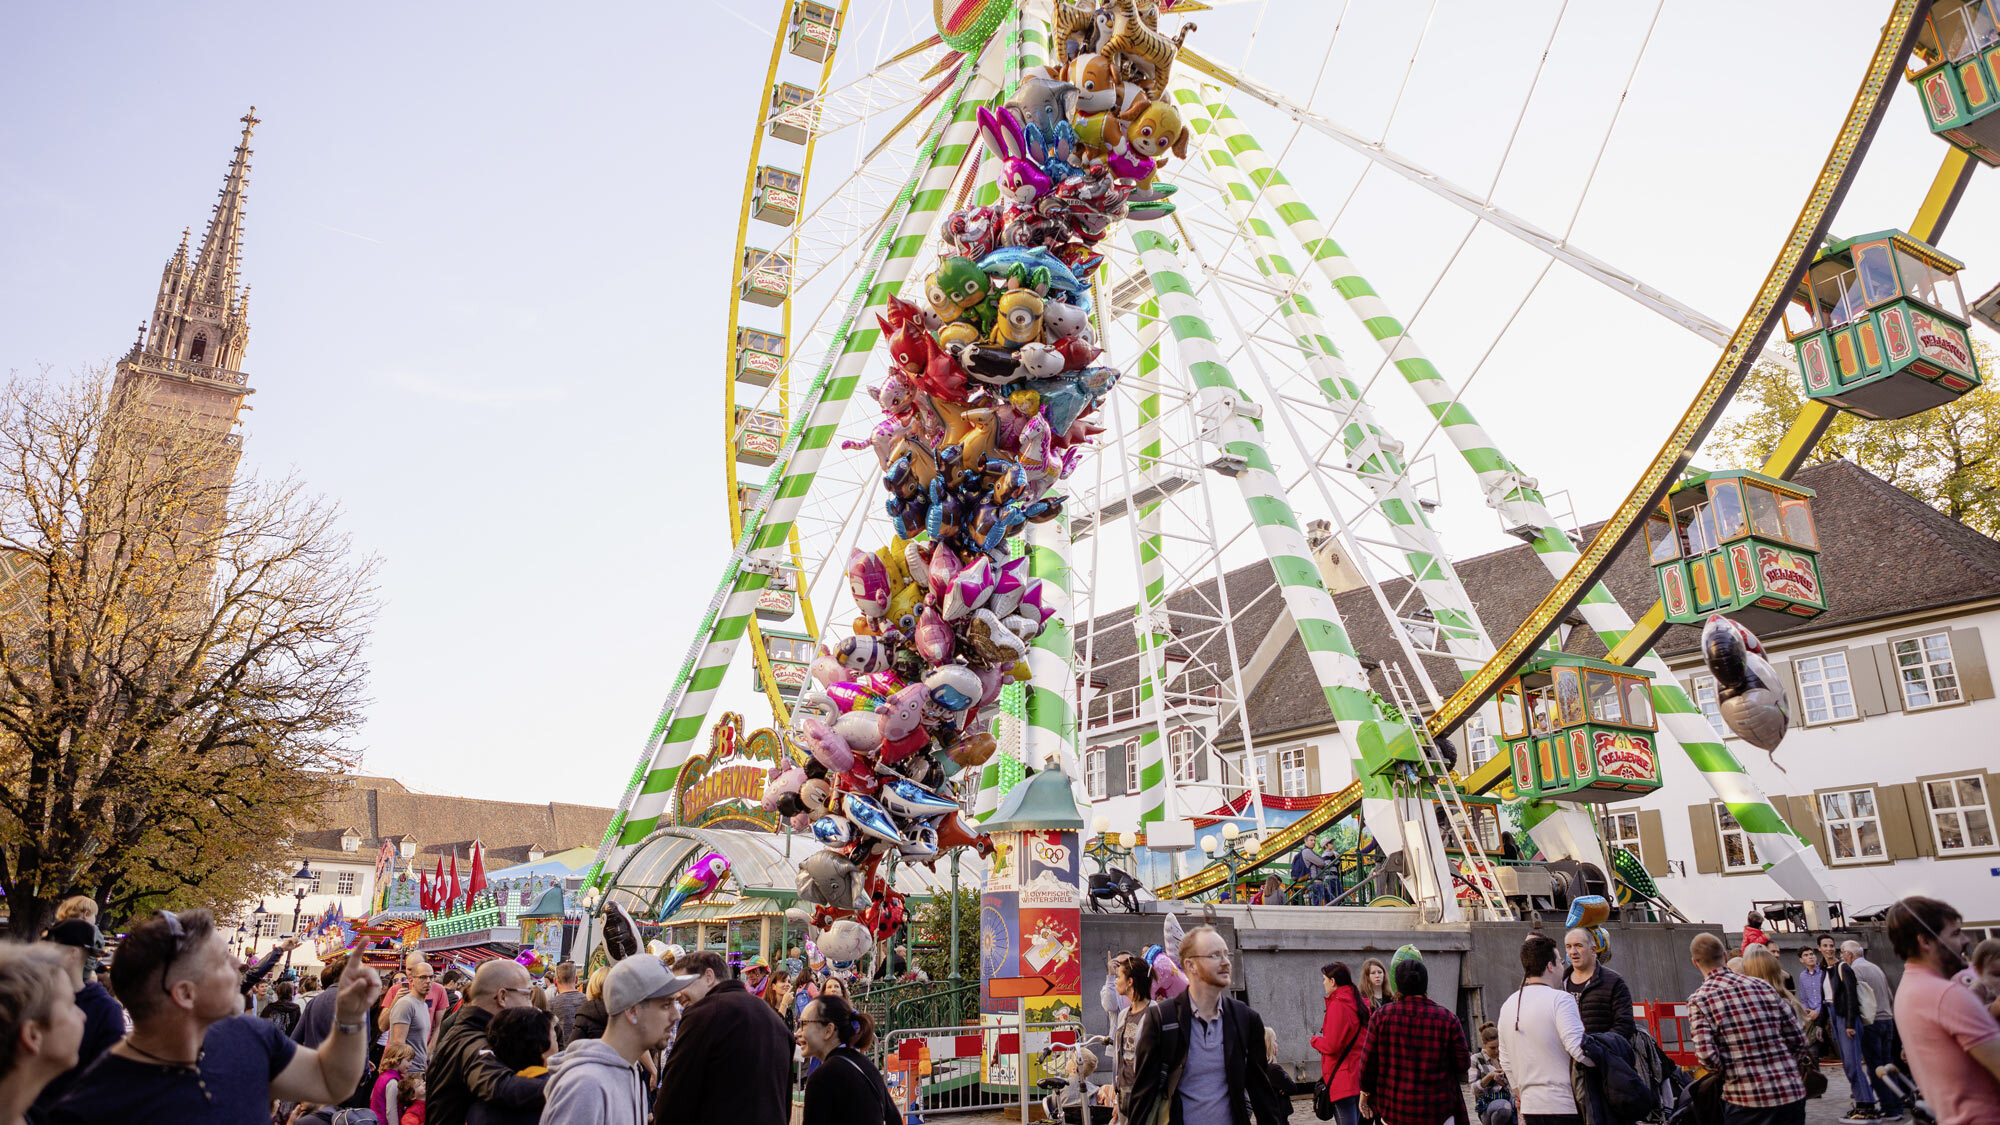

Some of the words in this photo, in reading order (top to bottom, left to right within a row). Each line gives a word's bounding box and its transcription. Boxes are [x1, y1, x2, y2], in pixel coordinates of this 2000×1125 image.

[1920, 334, 1967, 365] BELLEVUE
[751, 359, 777, 370] BELLEVUE
[748, 440, 775, 450] BELLEVUE
[1765, 567, 1814, 593] BELLEVUE
[775, 672, 805, 681] BELLEVUE
[1601, 750, 1650, 771] BELLEVUE
[683, 765, 767, 822] BELLEVUE
[1030, 890, 1070, 898] OLYMPISCHE
